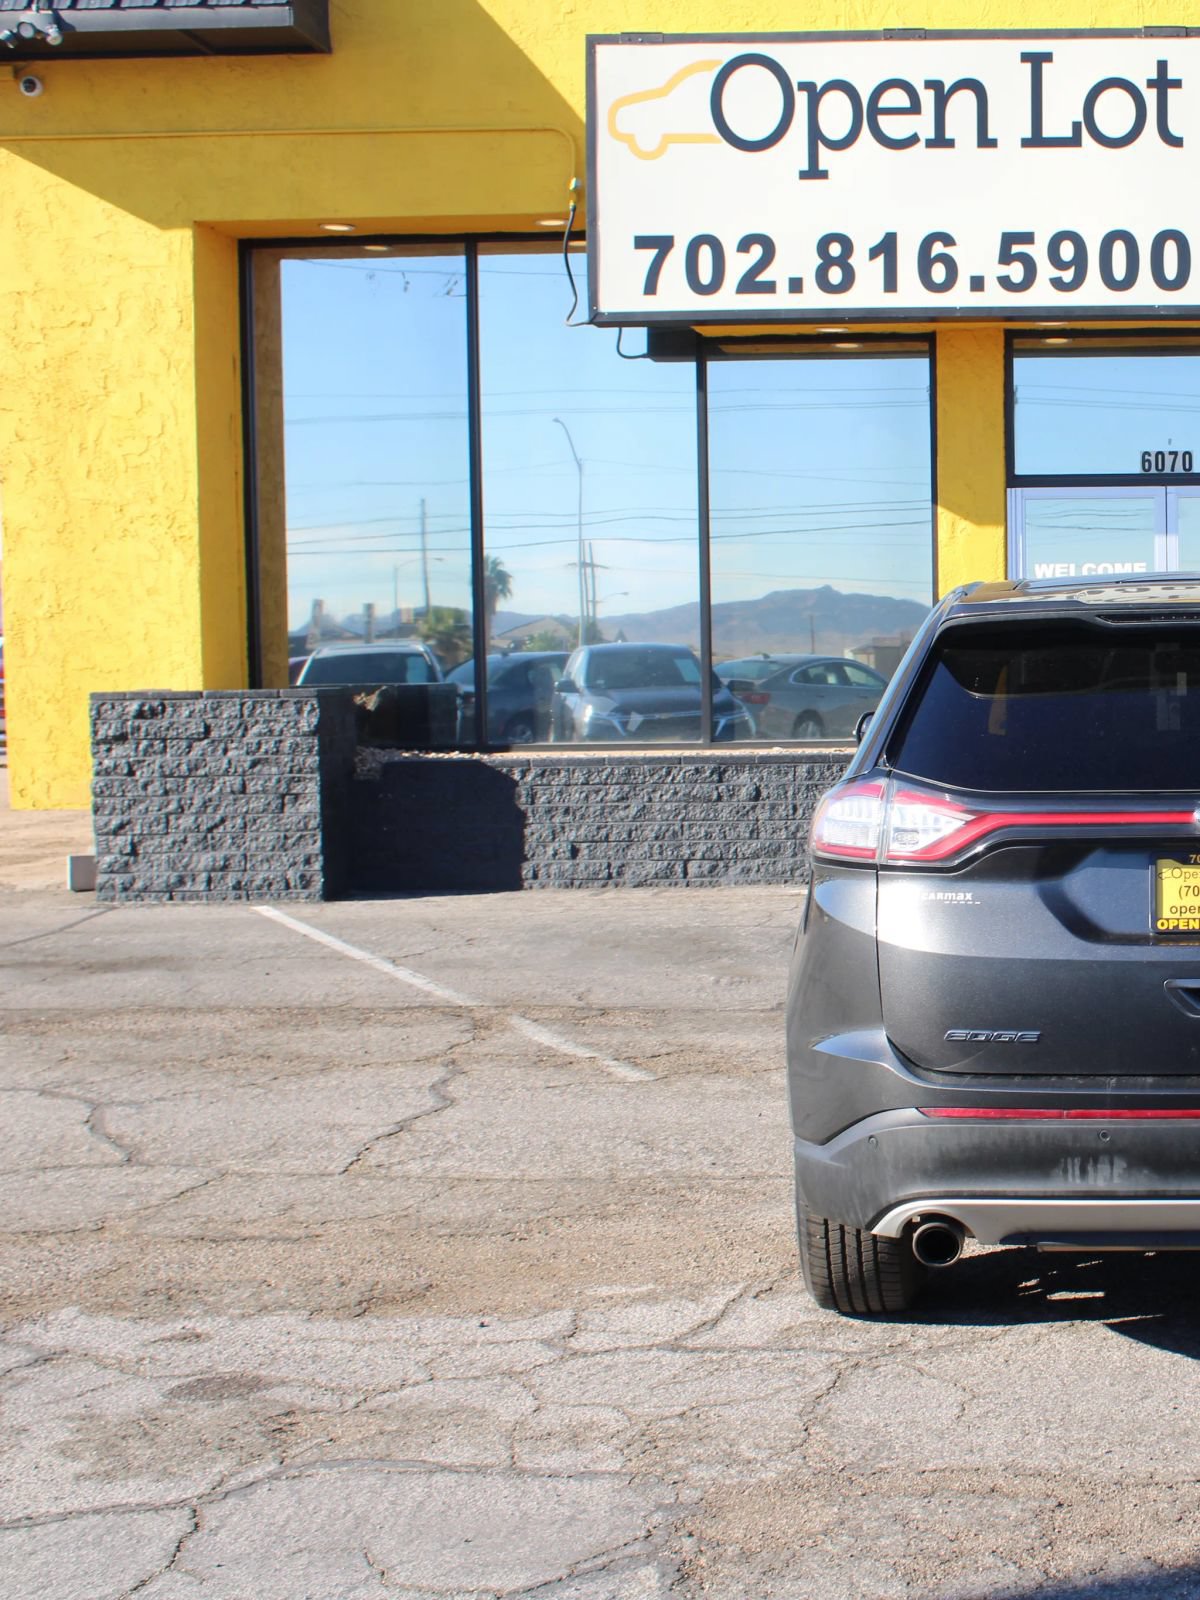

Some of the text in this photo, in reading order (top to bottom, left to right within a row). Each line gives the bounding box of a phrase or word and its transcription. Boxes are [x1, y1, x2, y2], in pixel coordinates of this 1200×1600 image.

[710, 53, 998, 180] Open
[1020, 52, 1184, 149] Lot
[633, 229, 1192, 296] 702.816.5900
[1141, 451, 1193, 473] 6070
[1034, 562, 1147, 579] WELCOME
[943, 1029, 1041, 1042] EDGE
